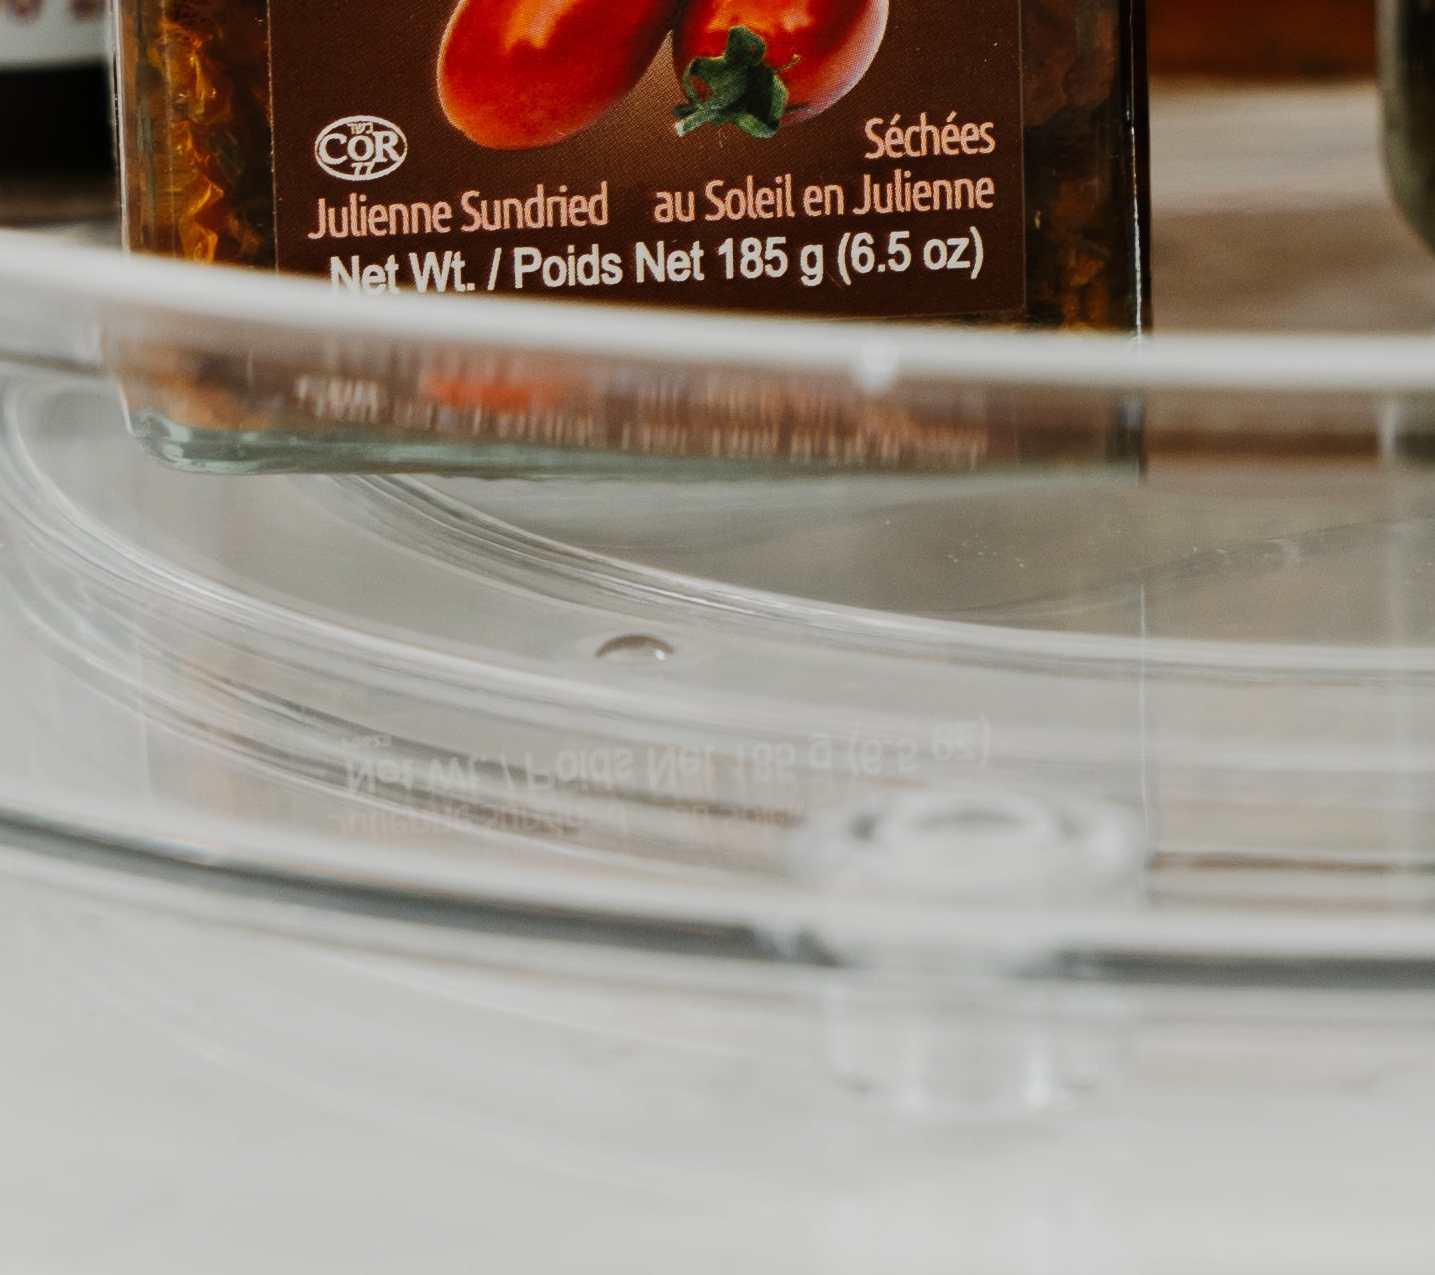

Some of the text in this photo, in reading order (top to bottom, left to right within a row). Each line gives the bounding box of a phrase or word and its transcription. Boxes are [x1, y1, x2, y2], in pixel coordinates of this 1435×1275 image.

[318, 131, 401, 165] COR
[864, 111, 997, 159] Séchées
[308, 180, 609, 240] Julienne Sundried
[654, 168, 996, 223] au Soleil en Julienne
[330, 254, 401, 296] Net
[409, 250, 476, 293] Wt.
[514, 243, 624, 289] Poids
[635, 240, 705, 283] Net
[717, 236, 789, 280] 185
[800, 244, 825, 287] g
[837, 231, 913, 285] (6.5
[923, 225, 984, 280] oz)
